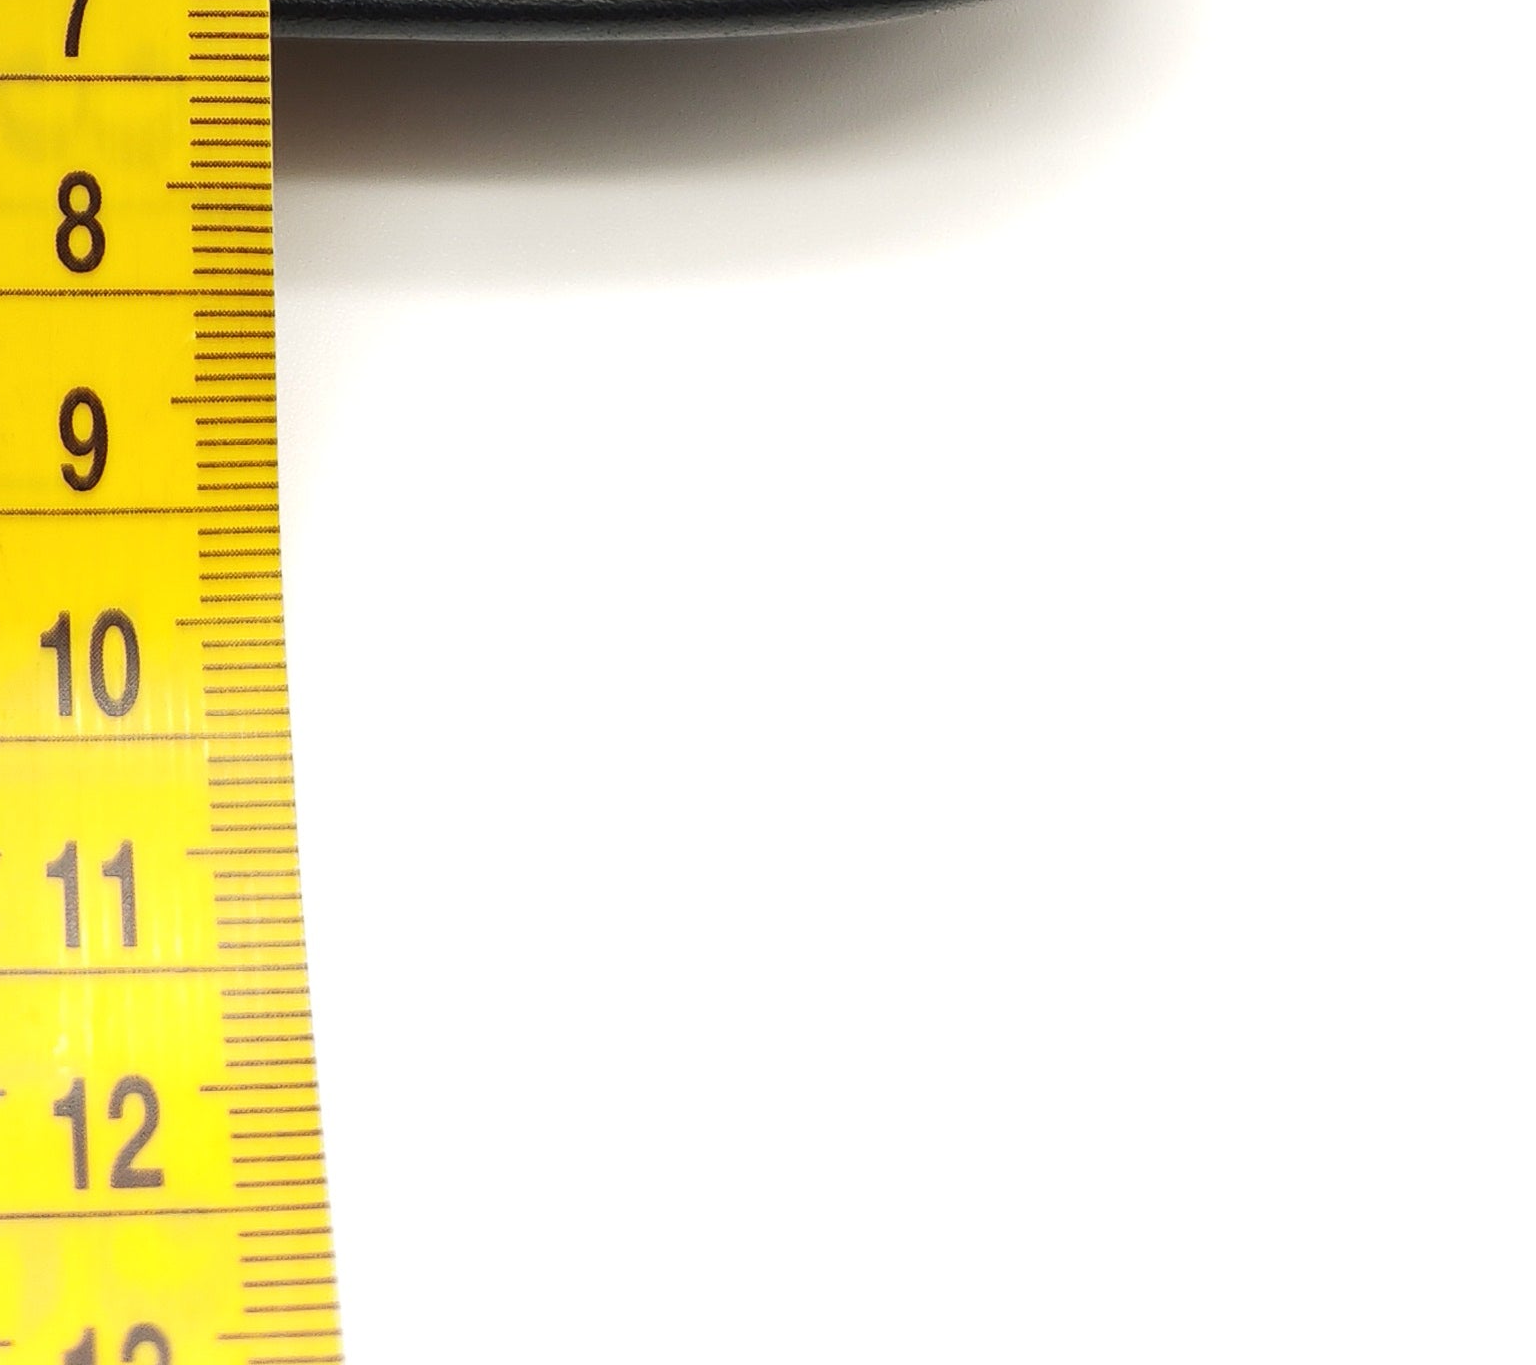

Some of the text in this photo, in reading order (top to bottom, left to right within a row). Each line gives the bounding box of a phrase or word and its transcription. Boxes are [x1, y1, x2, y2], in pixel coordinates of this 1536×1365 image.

[55, 170, 107, 274] 8
[58, 388, 109, 493] 9
[40, 607, 142, 718] 10
[46, 839, 139, 949] 11
[53, 1074, 165, 1190] 12
